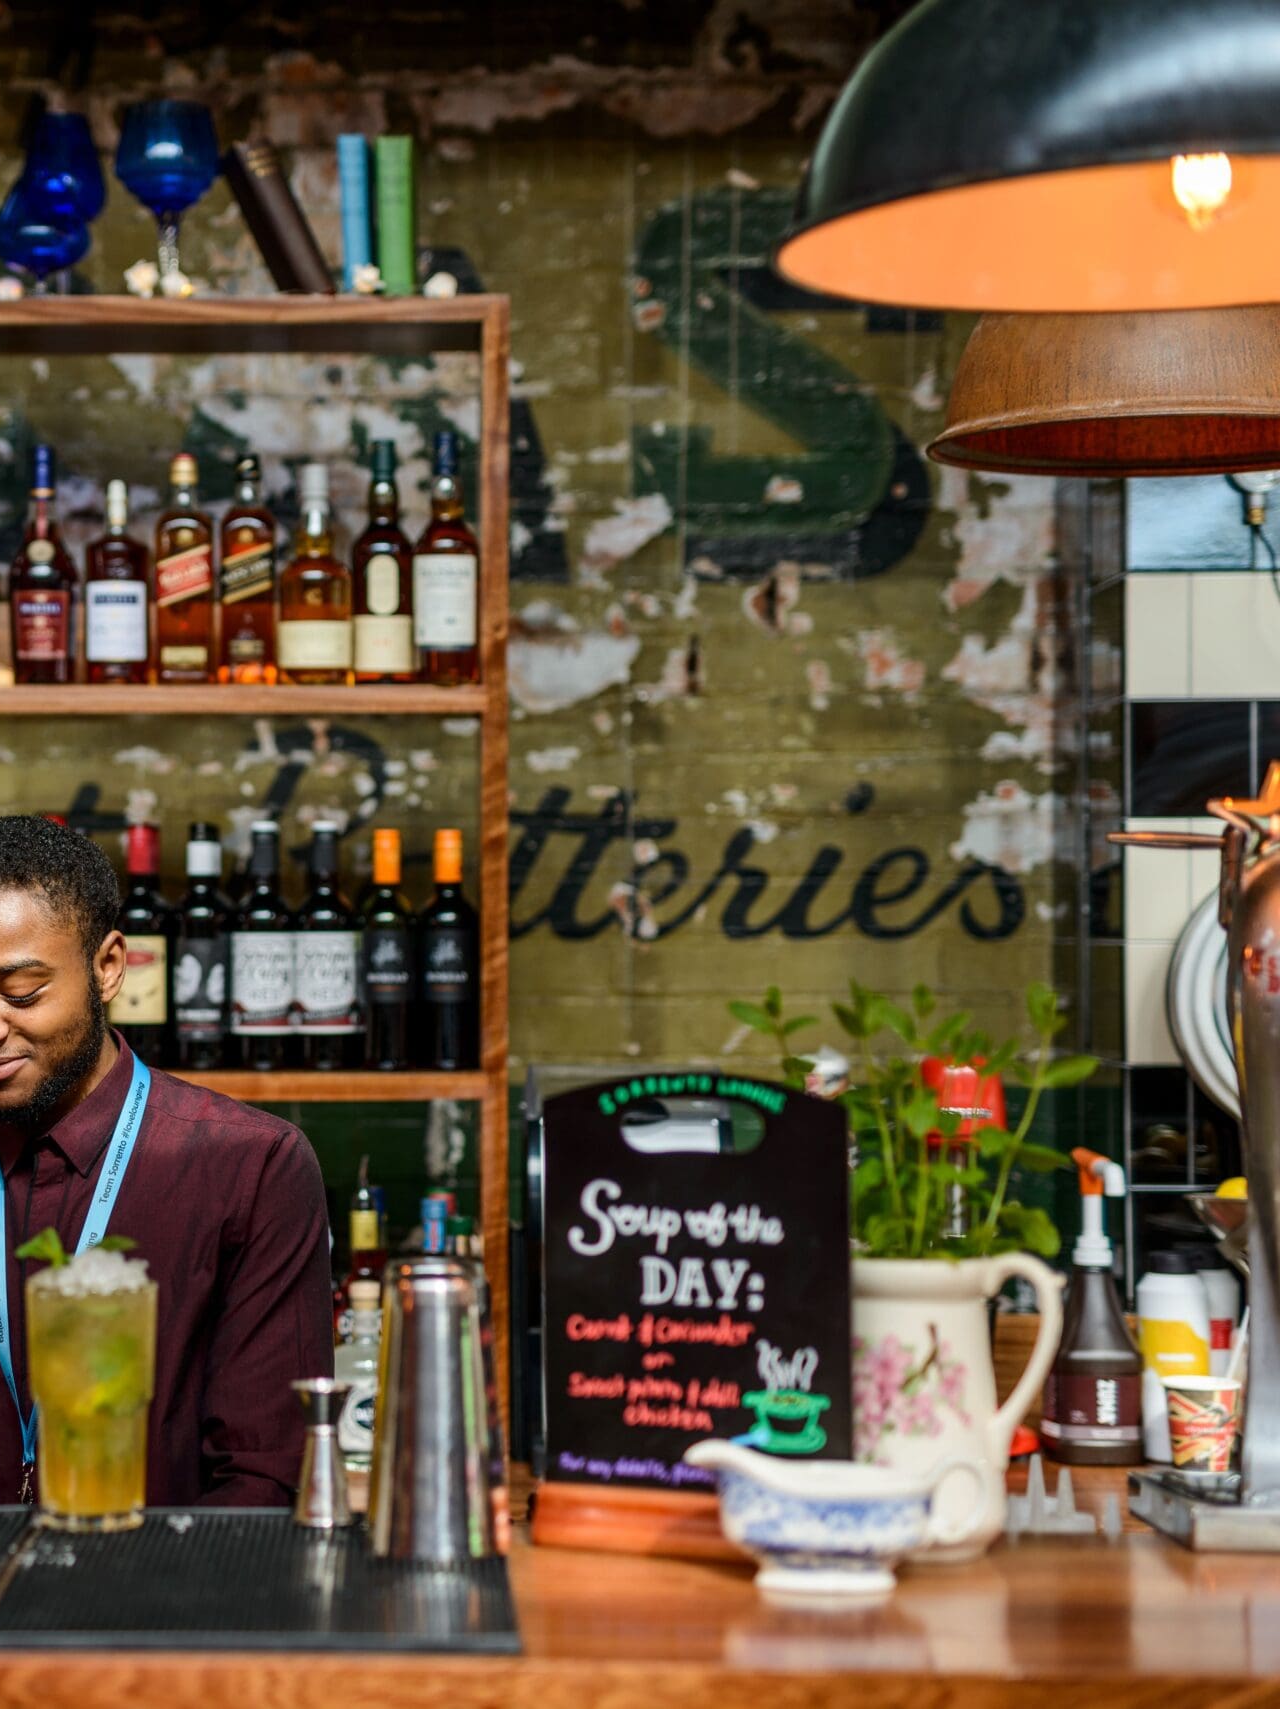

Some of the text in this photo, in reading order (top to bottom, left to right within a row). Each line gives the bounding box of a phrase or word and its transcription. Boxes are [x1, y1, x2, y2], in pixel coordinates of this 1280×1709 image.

[99, 1080, 146, 1204] Team Sorrento #lovelounging
[567, 1178, 786, 1256] Soup of the
[638, 1255, 766, 1312] DAY:
